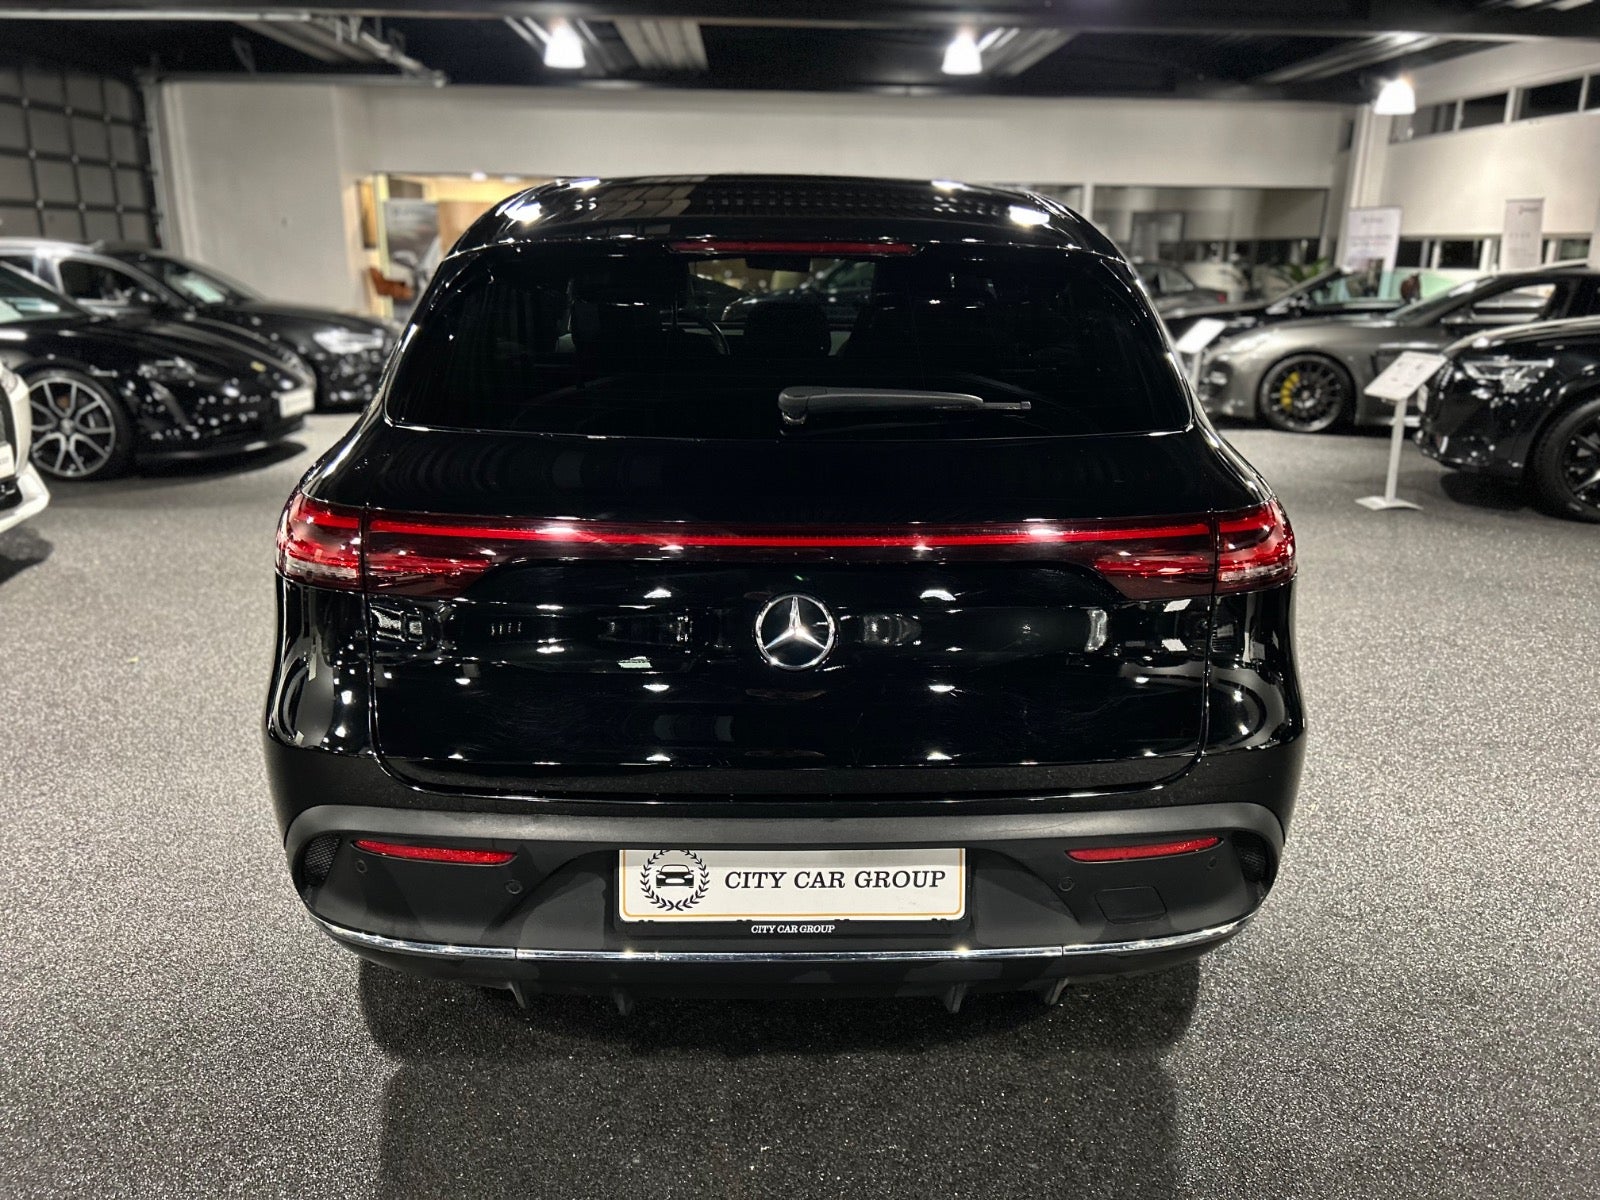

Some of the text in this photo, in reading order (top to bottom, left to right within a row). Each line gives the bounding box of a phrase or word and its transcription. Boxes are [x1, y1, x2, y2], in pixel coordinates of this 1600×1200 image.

[724, 870, 946, 889] CITY CAR GROUP
[750, 924, 836, 934] CITY CAR GROUP
